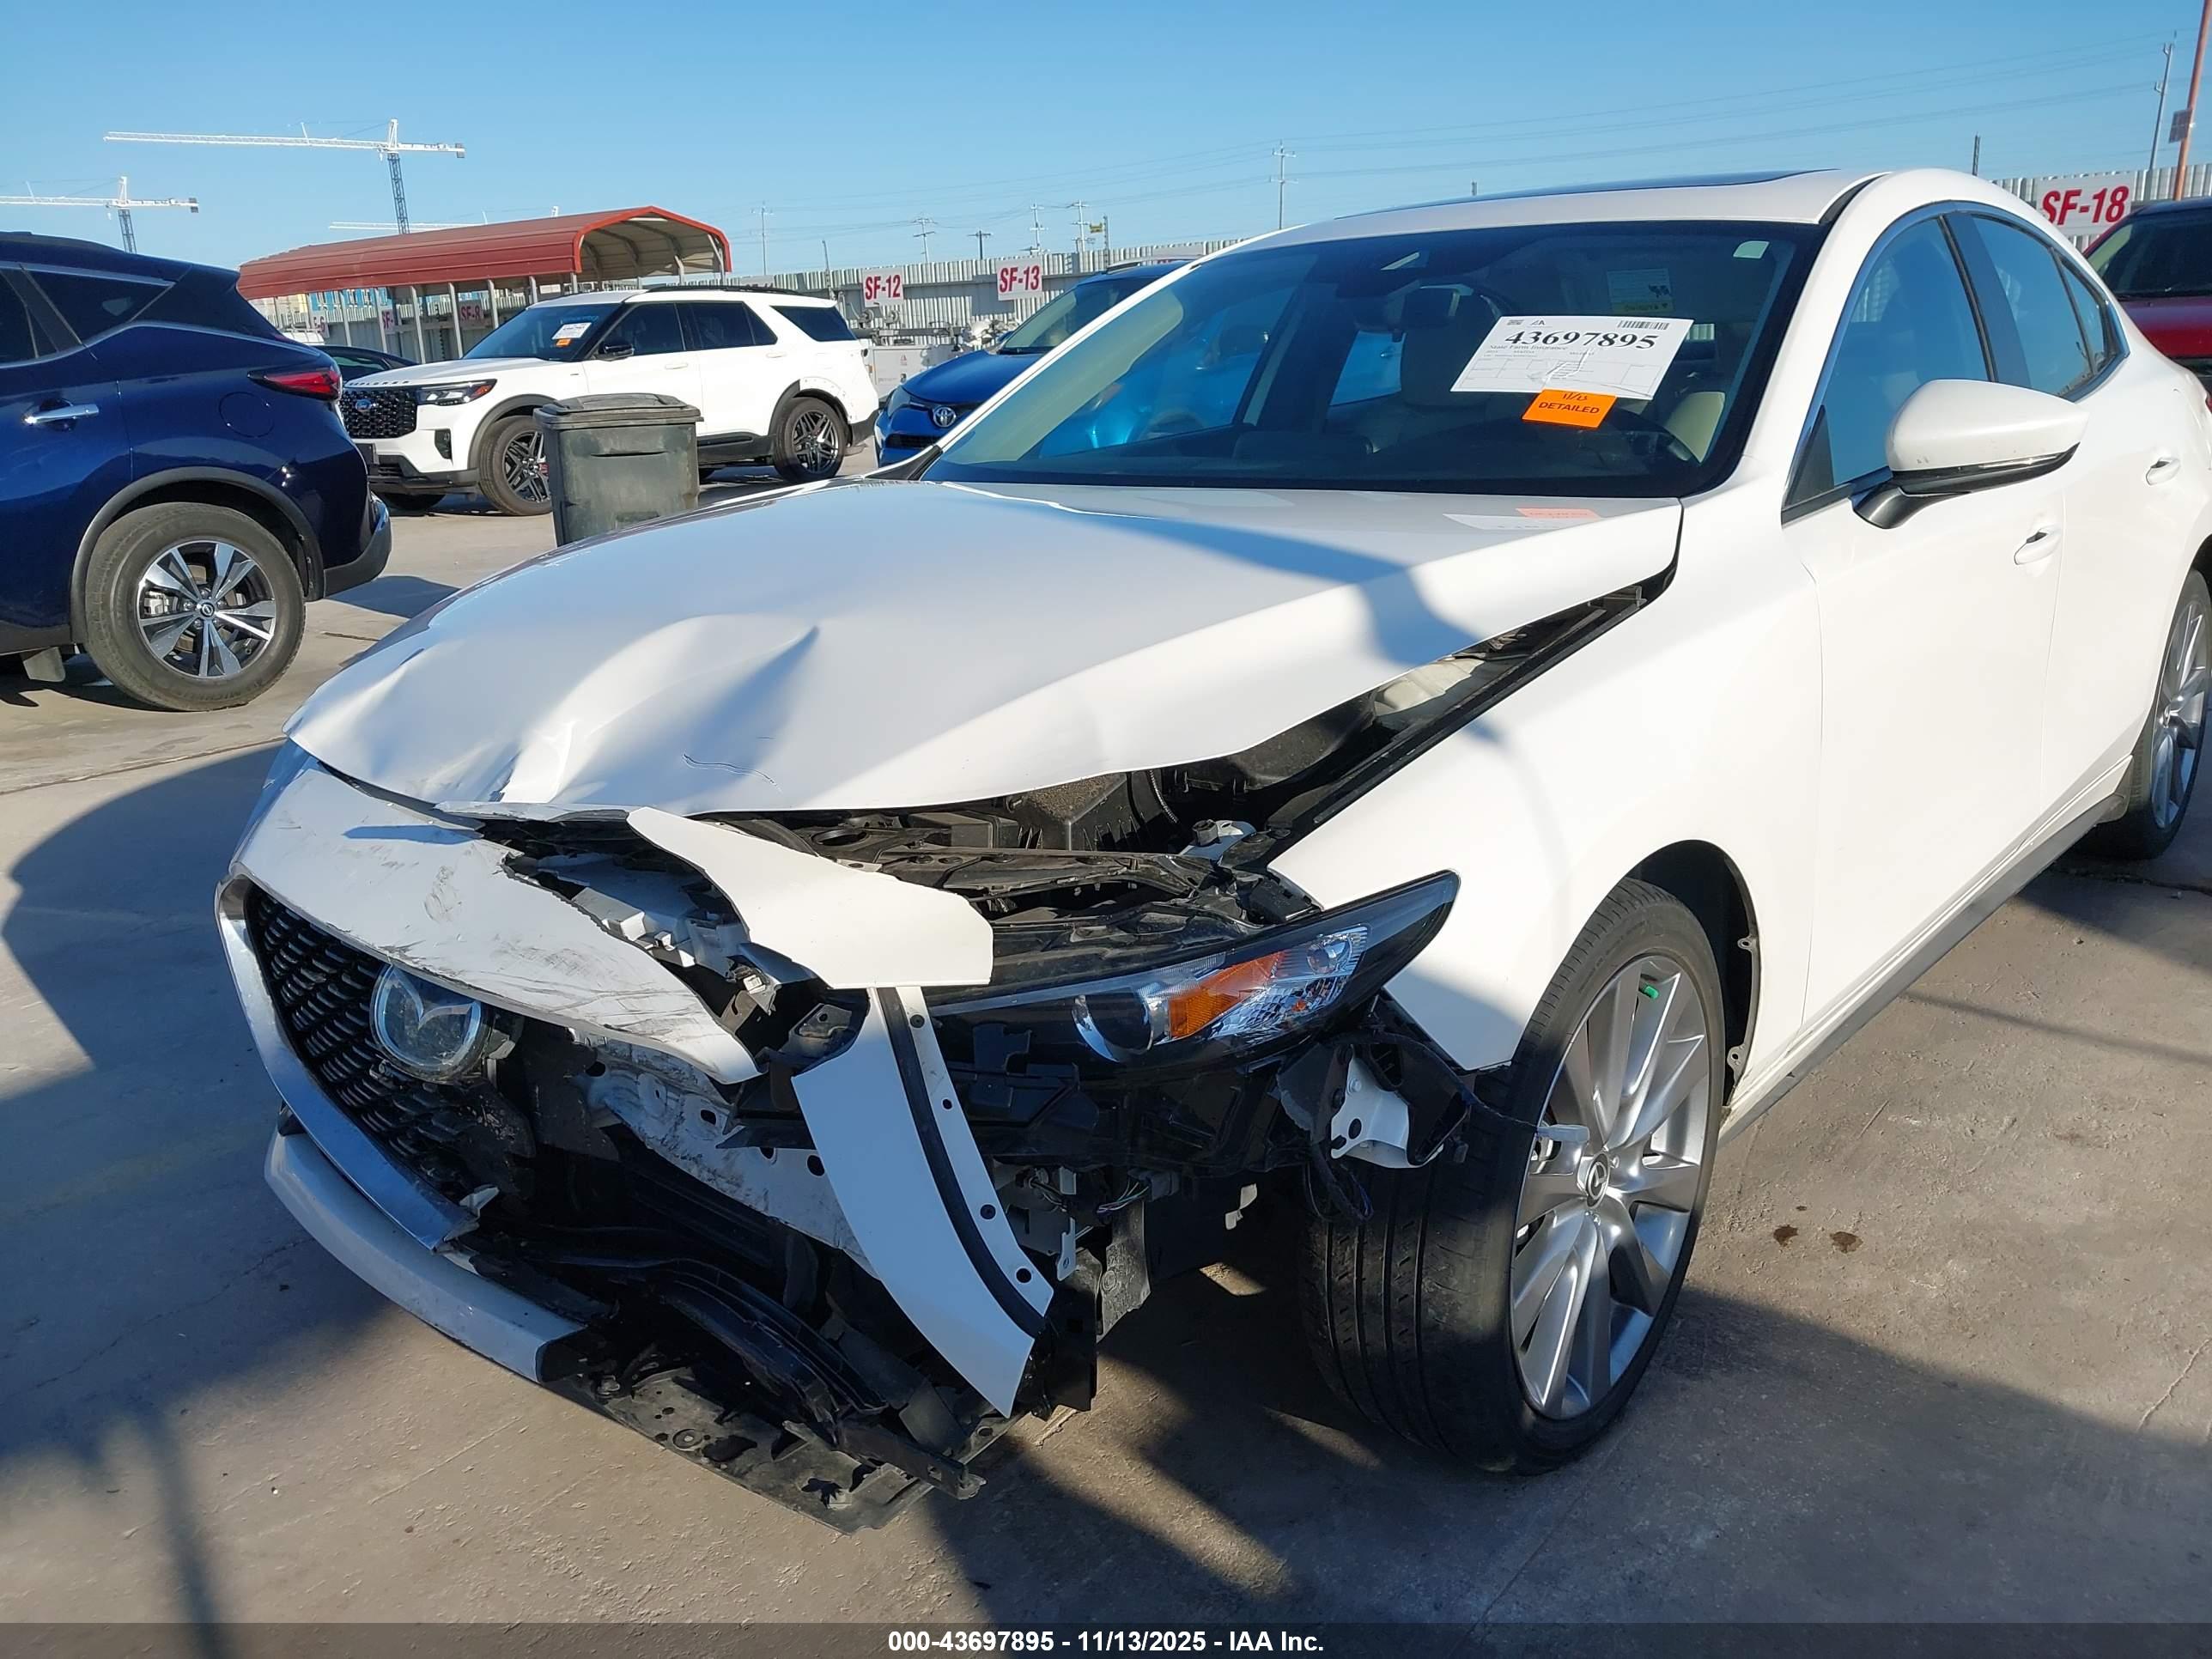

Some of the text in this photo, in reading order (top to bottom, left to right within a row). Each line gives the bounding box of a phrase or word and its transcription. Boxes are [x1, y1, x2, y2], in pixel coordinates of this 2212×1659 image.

[2042, 185, 2130, 226] SF-18
[865, 274, 901, 301] SF-12
[999, 264, 1041, 293] SF-13
[1504, 331, 1659, 350] 43697895
[1539, 402, 1600, 414] DETAILED
